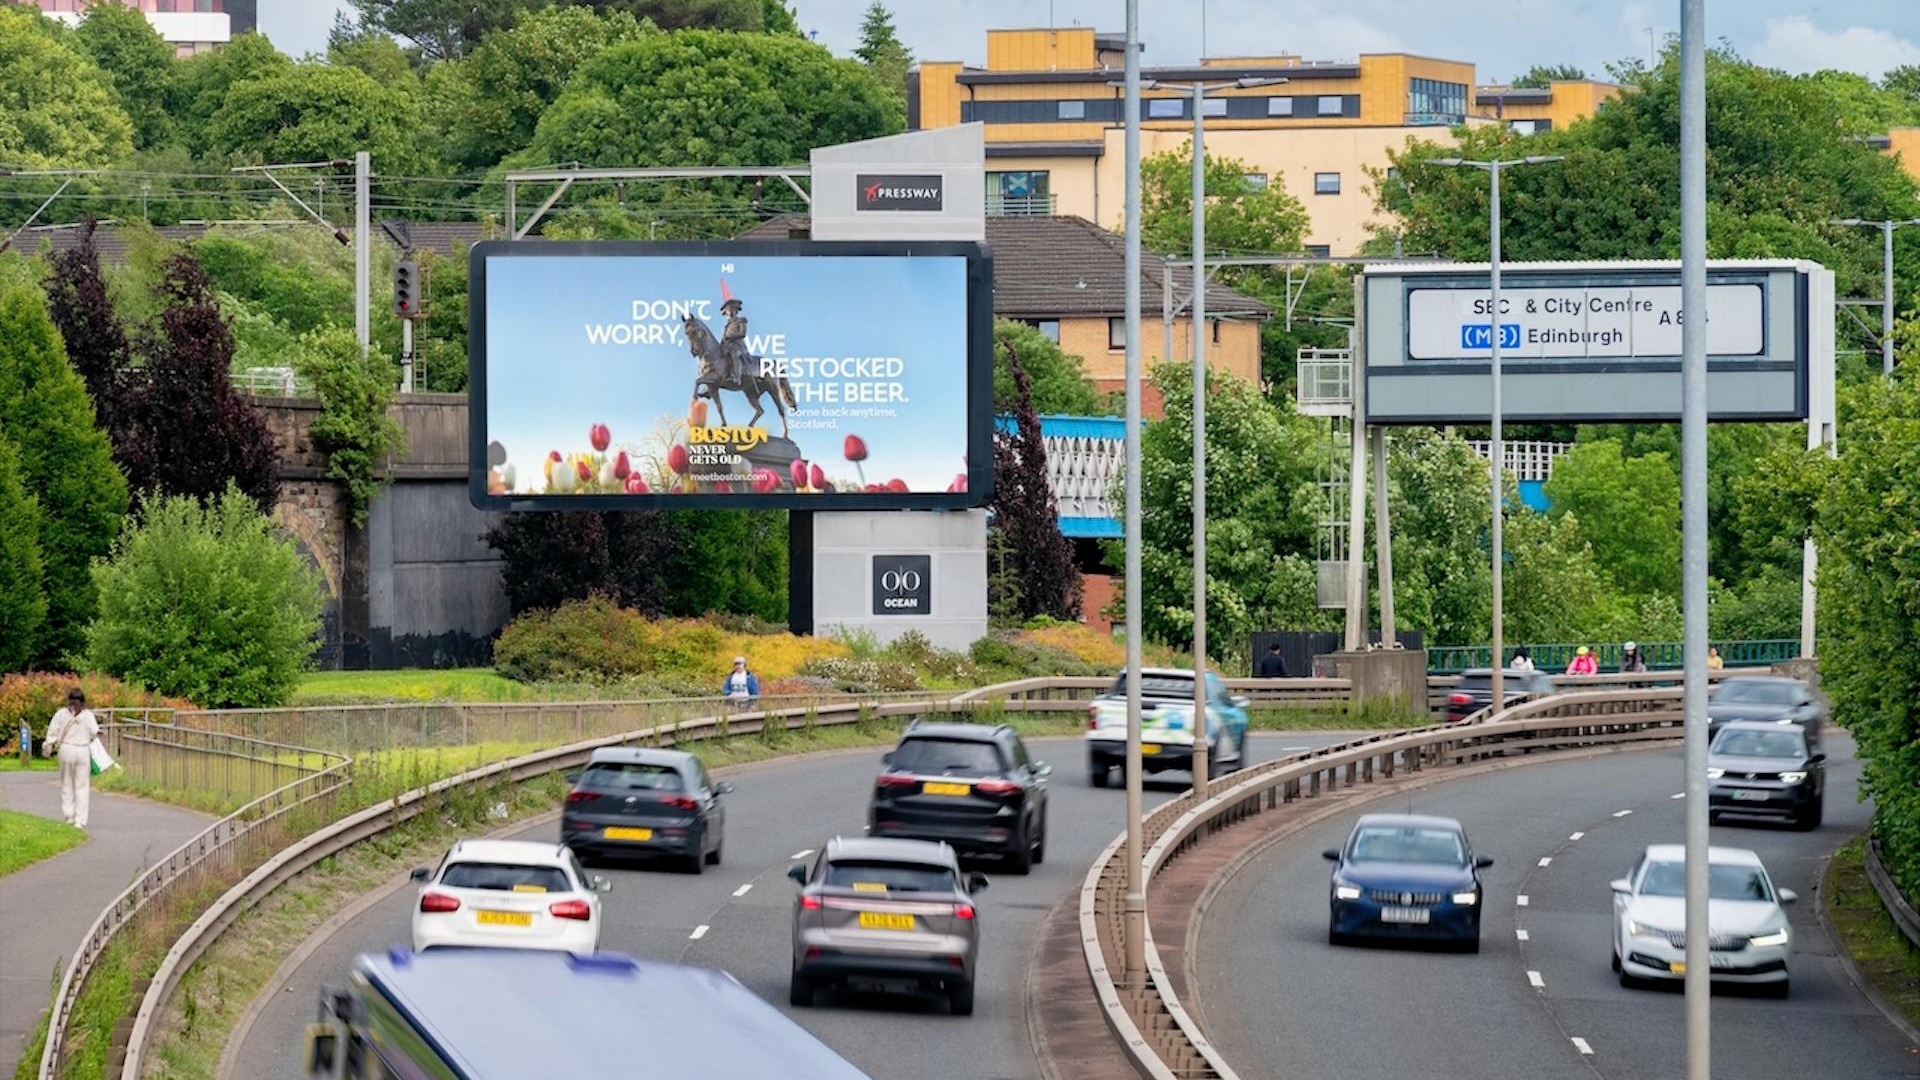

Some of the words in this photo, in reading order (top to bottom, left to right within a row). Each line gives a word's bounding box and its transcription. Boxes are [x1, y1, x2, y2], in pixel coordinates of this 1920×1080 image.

[878, 188, 939, 198] PRESSWAY
[632, 300, 711, 321] DON'T
[1473, 299, 1510, 314] SEC
[1525, 298, 1537, 313] &
[1544, 298, 1581, 315] City
[1589, 297, 1653, 312] Centre
[585, 324, 684, 347] WORRY,
[744, 334, 786, 355] WE
[1528, 328, 1623, 346] Edinburgh
[759, 357, 904, 378] RESTOCKED
[791, 382, 839, 402] THE
[844, 382, 909, 403] BEER.
[788, 407, 820, 417] Come
[822, 406, 849, 417] back
[850, 406, 897, 419] anytime,
[788, 418, 839, 429] Scotland.
[689, 426, 768, 451] BOSTON
[689, 445, 726, 454] NEVER
[689, 454, 718, 464] GETS
[719, 454, 742, 465] OLD
[690, 472, 768, 481] meetboston.com
[884, 598, 918, 608] OCEAN
